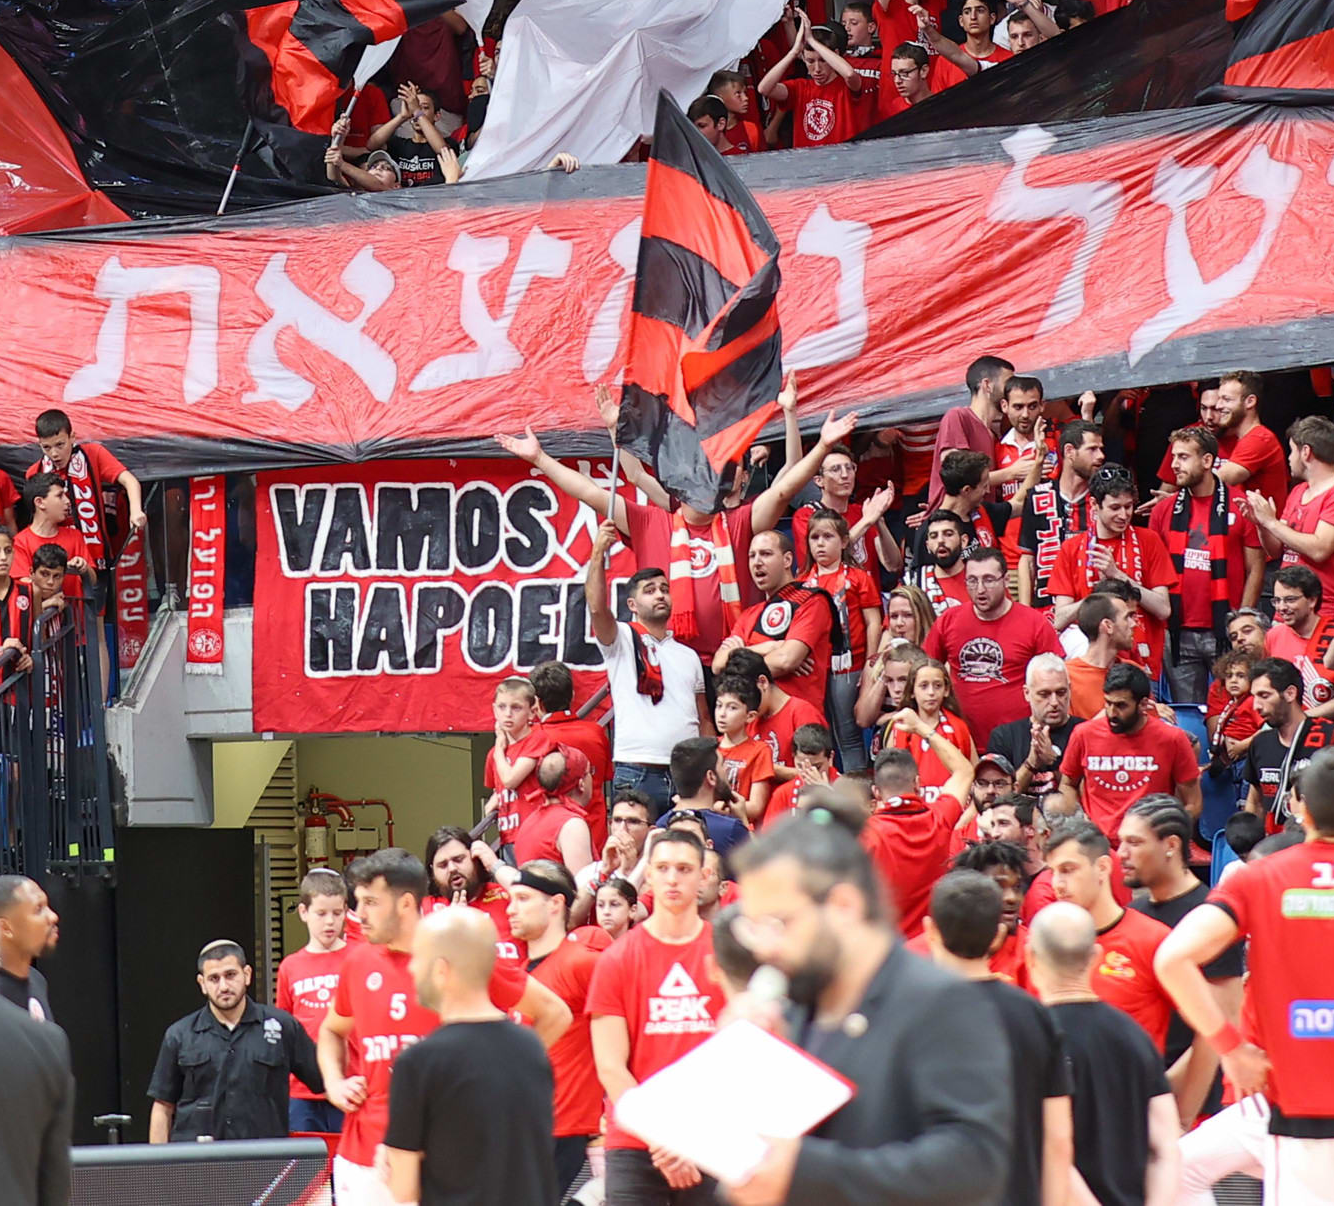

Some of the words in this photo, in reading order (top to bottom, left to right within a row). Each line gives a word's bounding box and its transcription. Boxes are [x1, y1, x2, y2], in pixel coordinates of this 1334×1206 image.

[73, 483, 102, 546] 2021
[269, 480, 559, 578] VAMOS
[1087, 756, 1159, 772] HAPOEL
[389, 993, 407, 1021] 5
[648, 996, 712, 1021] PEAK
